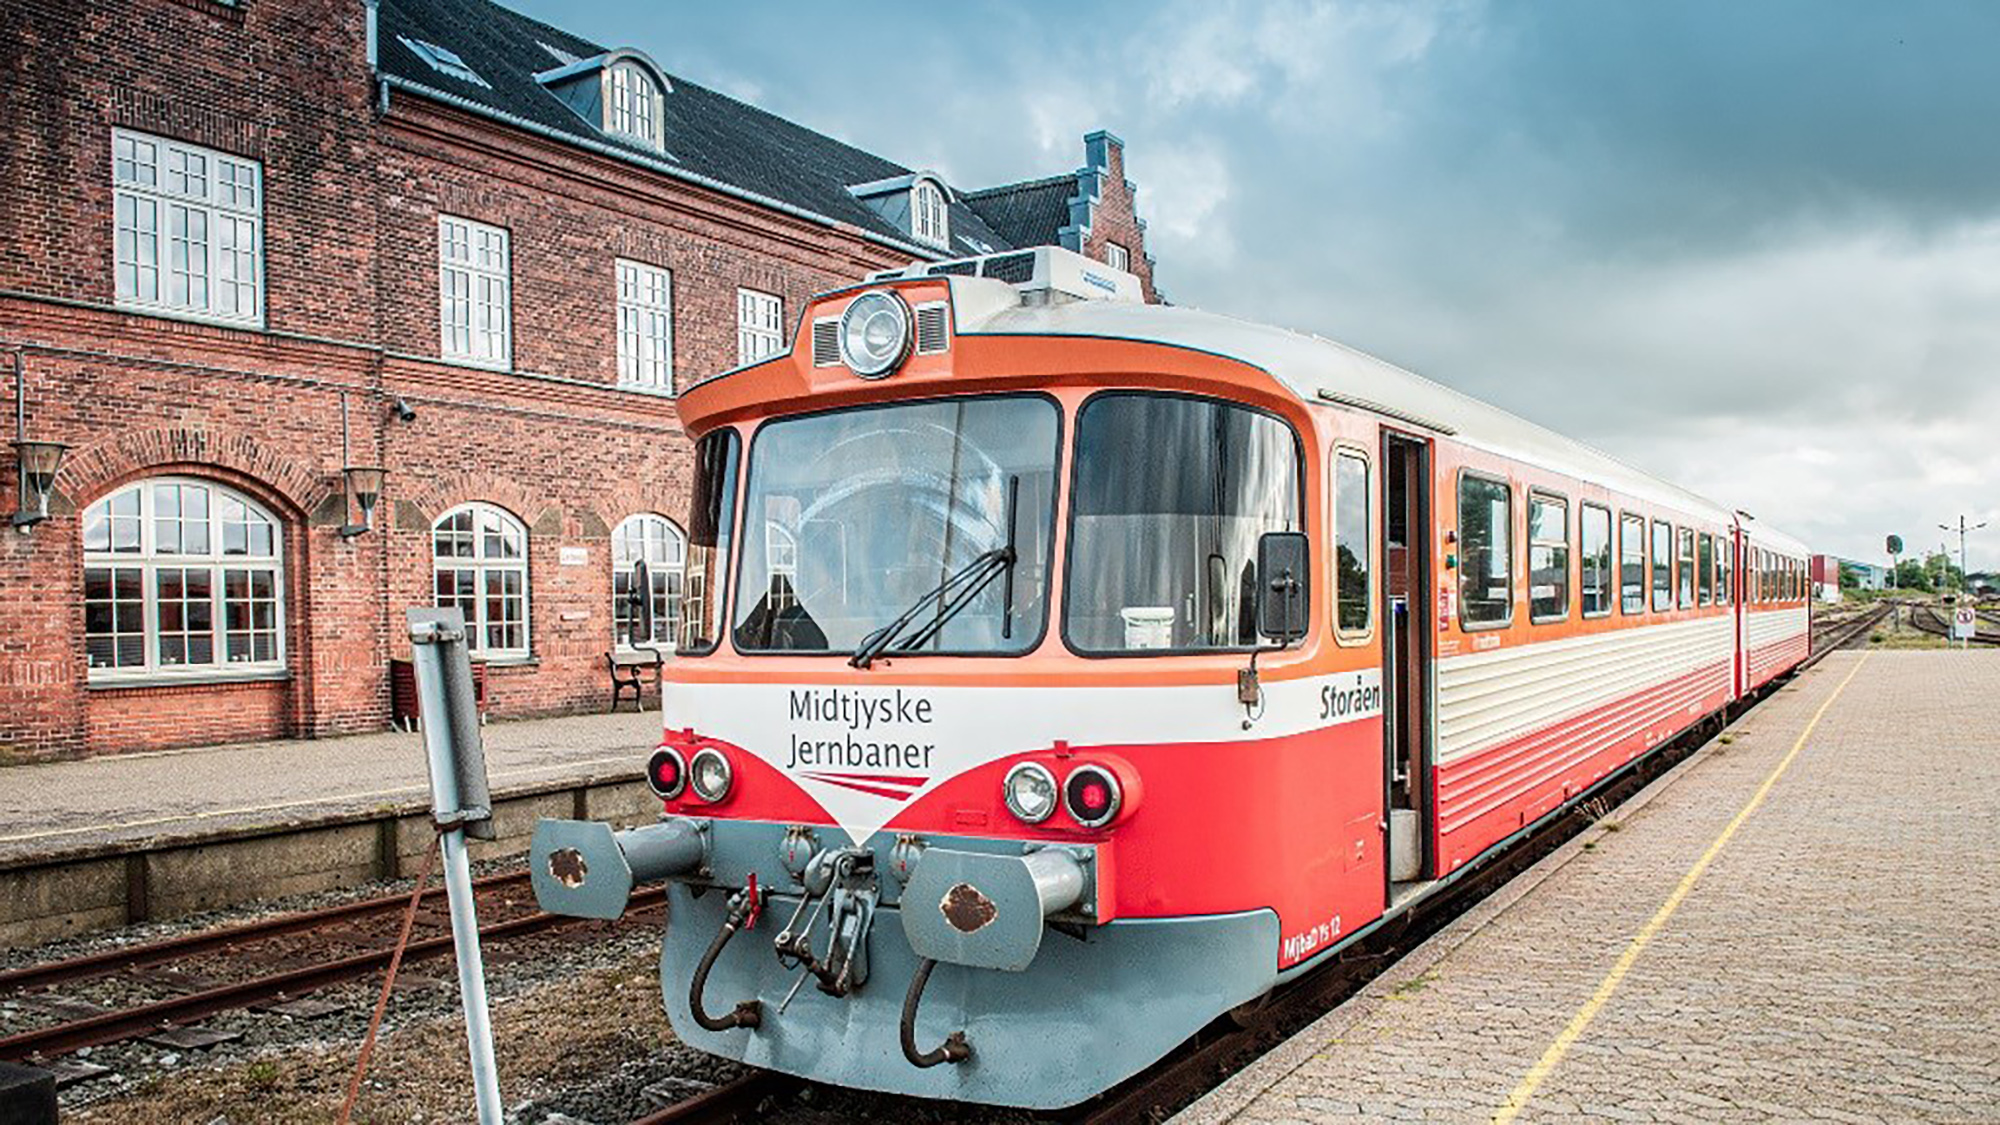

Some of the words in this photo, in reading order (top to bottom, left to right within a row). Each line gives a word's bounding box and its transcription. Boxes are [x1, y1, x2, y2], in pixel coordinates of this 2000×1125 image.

[789, 688, 933, 729] Midtjyske
[1320, 674, 1380, 720] Storåen
[786, 733, 935, 769] Jernbaner
